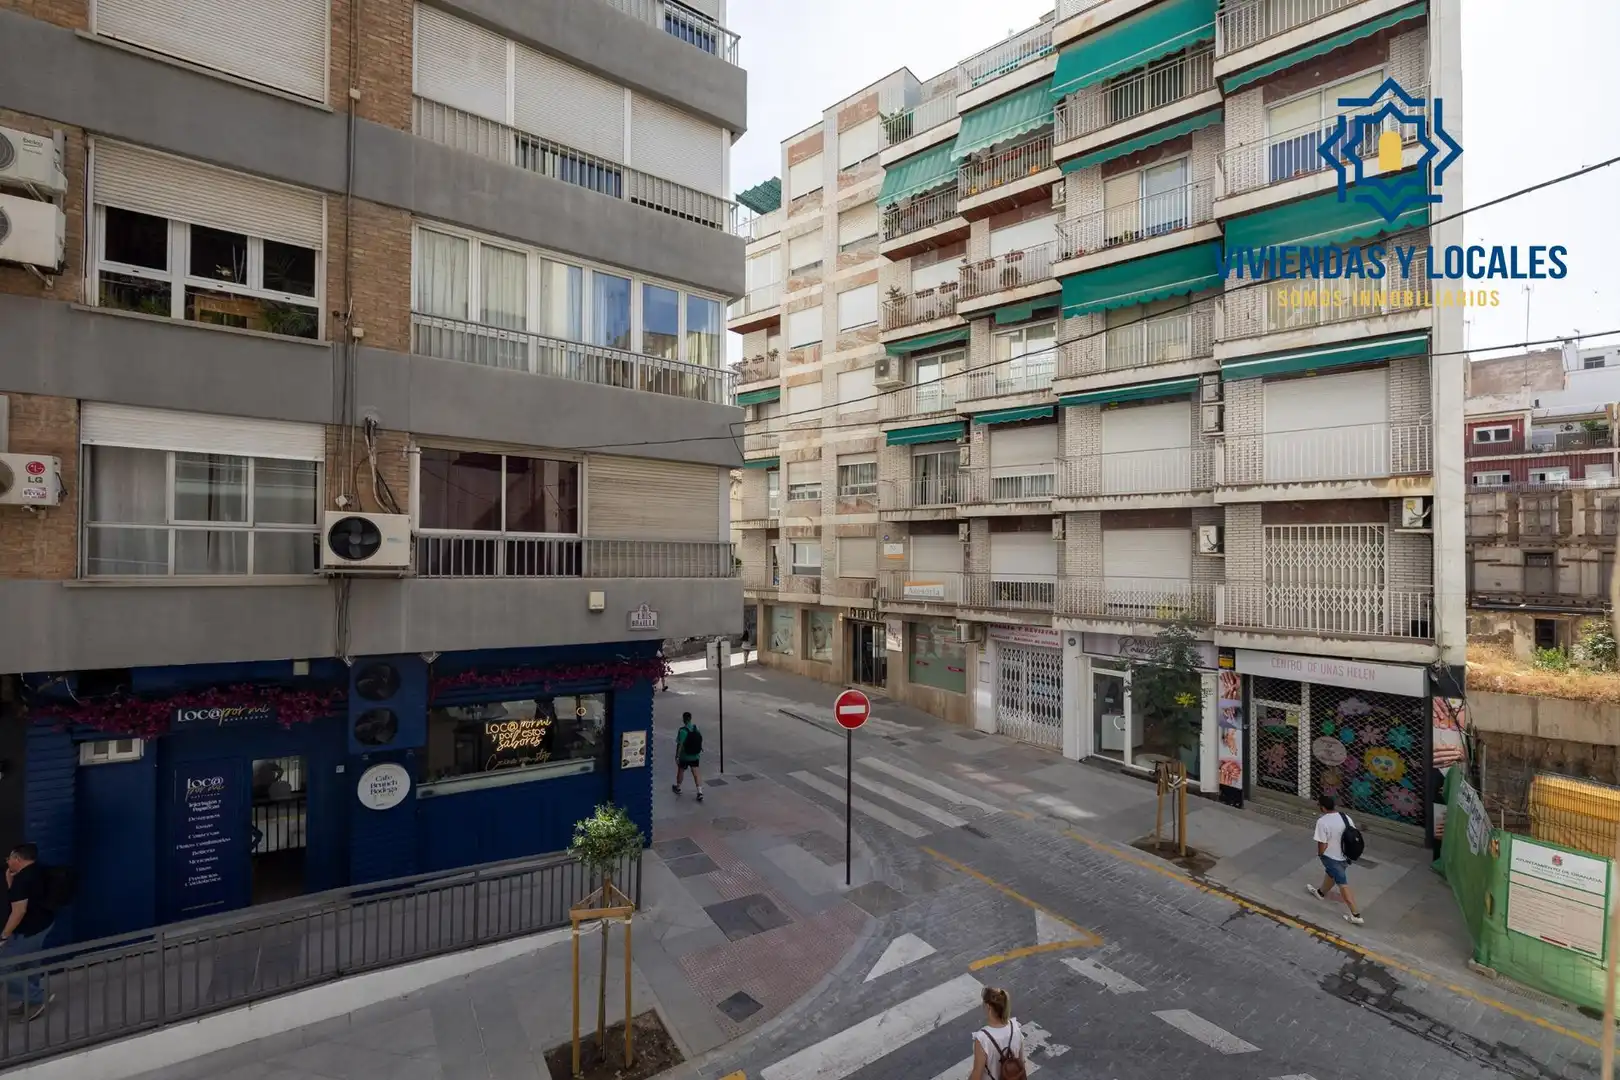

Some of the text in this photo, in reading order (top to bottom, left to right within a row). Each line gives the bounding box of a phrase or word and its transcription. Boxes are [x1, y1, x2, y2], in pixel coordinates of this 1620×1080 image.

[27, 475, 44, 484] LG
[1270, 657, 1303, 671] CENTRO
[1307, 662, 1317, 673] DE
[1346, 666, 1376, 681] HELEN
[521, 728, 546, 738] estos
[496, 733, 542, 752] sabores
